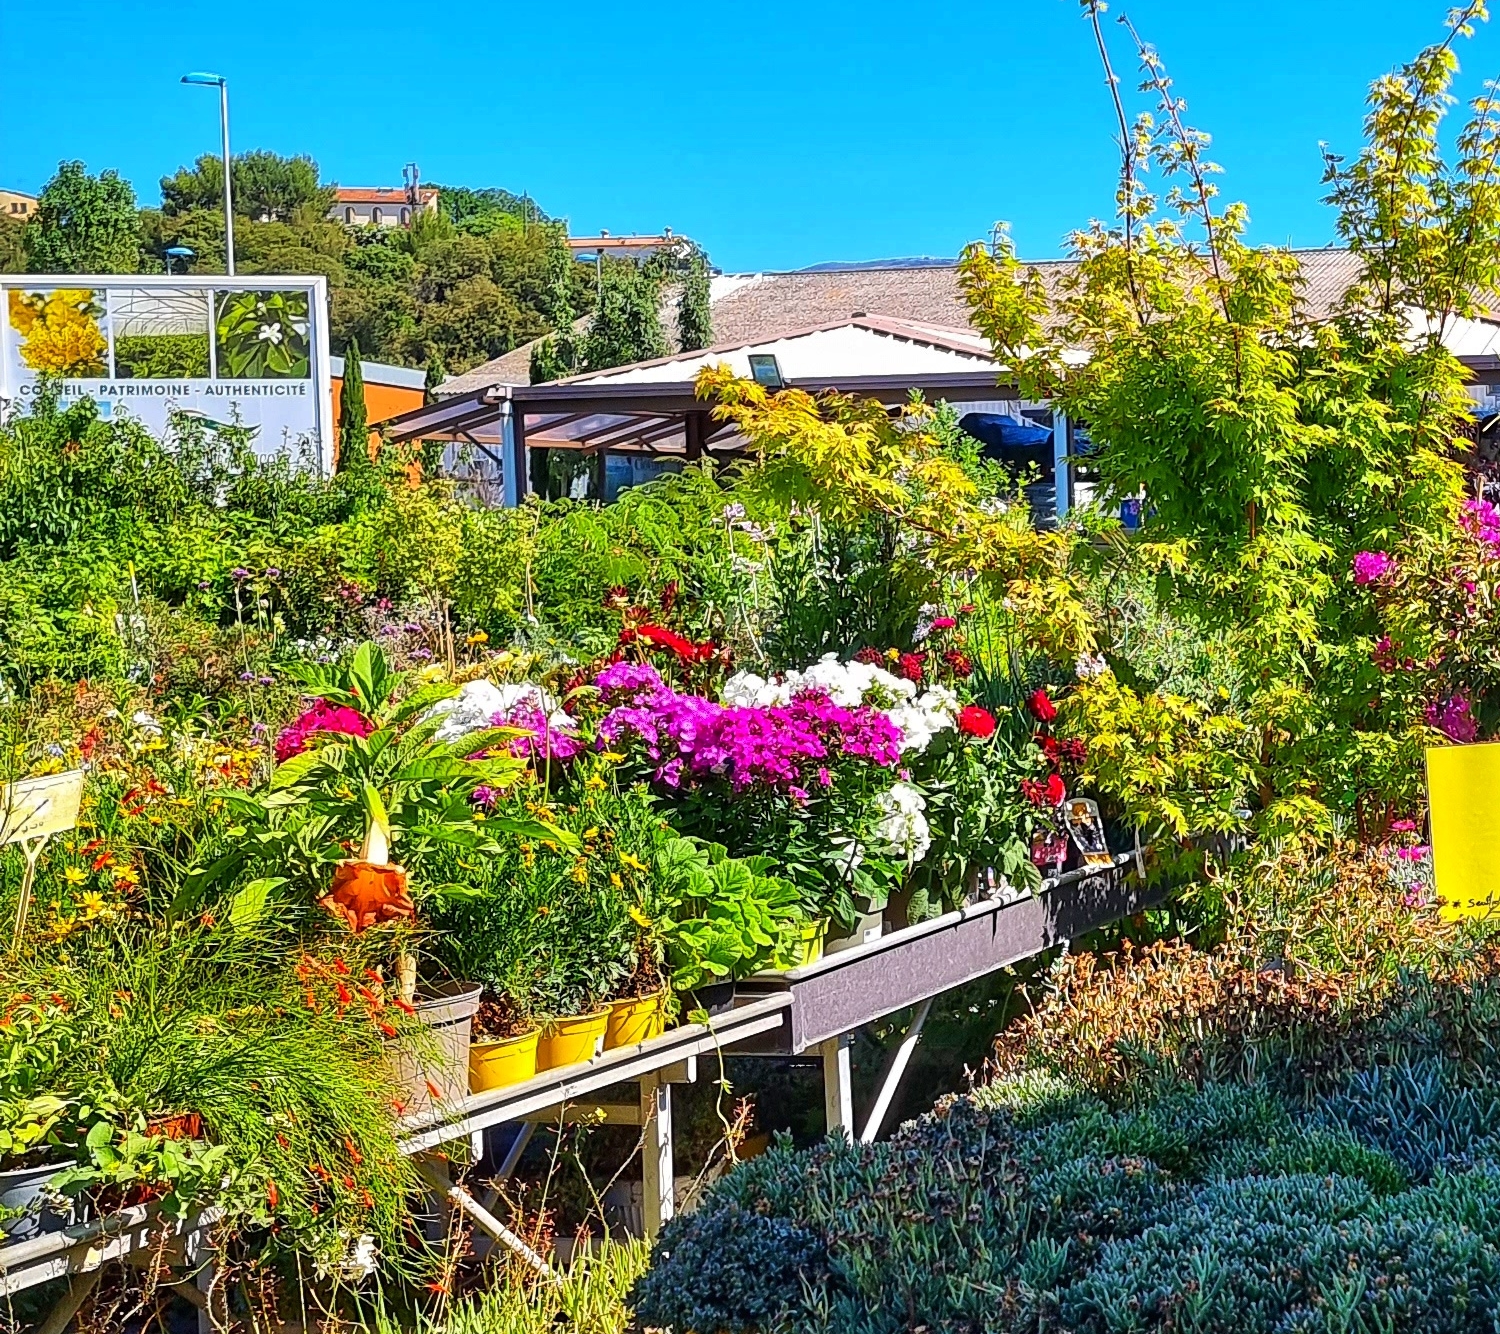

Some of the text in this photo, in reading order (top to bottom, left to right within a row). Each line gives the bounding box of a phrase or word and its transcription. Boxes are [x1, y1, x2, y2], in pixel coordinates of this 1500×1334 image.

[19, 384, 85, 396] COSEIL
[100, 384, 190, 396] PATRIMOINE
[204, 381, 306, 396] AUTHENTICITÉ
